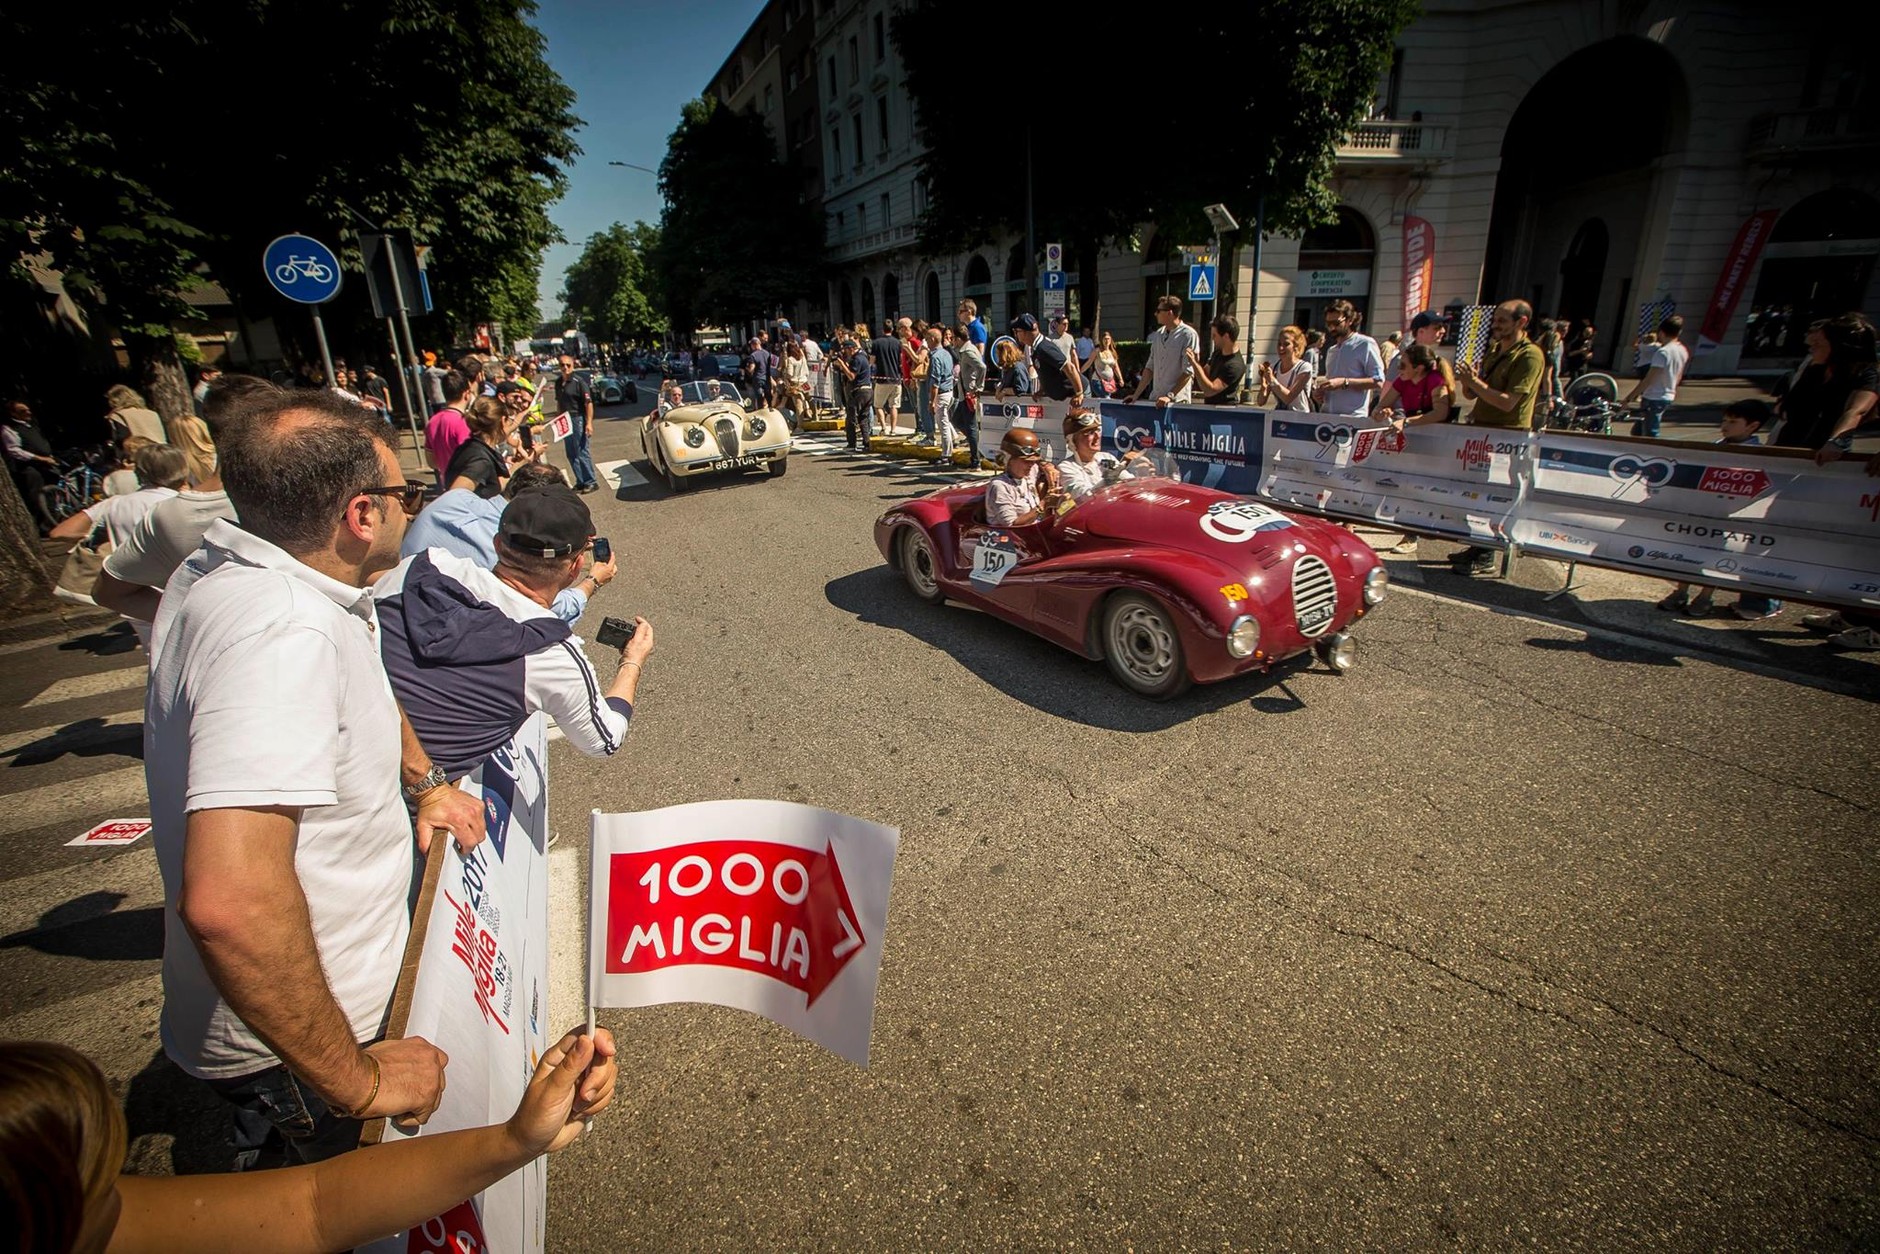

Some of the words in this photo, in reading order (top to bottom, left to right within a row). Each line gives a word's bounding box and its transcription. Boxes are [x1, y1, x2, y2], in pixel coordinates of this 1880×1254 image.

[1049, 273, 1058, 289] P
[1163, 429, 1197, 449] MILLE
[1202, 432, 1245, 456] MIGLIA
[1465, 434, 1493, 453] Mille
[1496, 442, 1528, 456] 2017
[736, 456, 756, 467] YUR
[1712, 469, 1756, 482] 1000
[1703, 480, 1754, 494] MIGLIA
[1230, 506, 1271, 520] 150
[1663, 521, 1776, 546] CHOPARD
[982, 551, 1005, 573] 150
[1219, 583, 1249, 601] 150
[638, 852, 810, 906] 1000
[620, 912, 811, 979] MIGLIA
